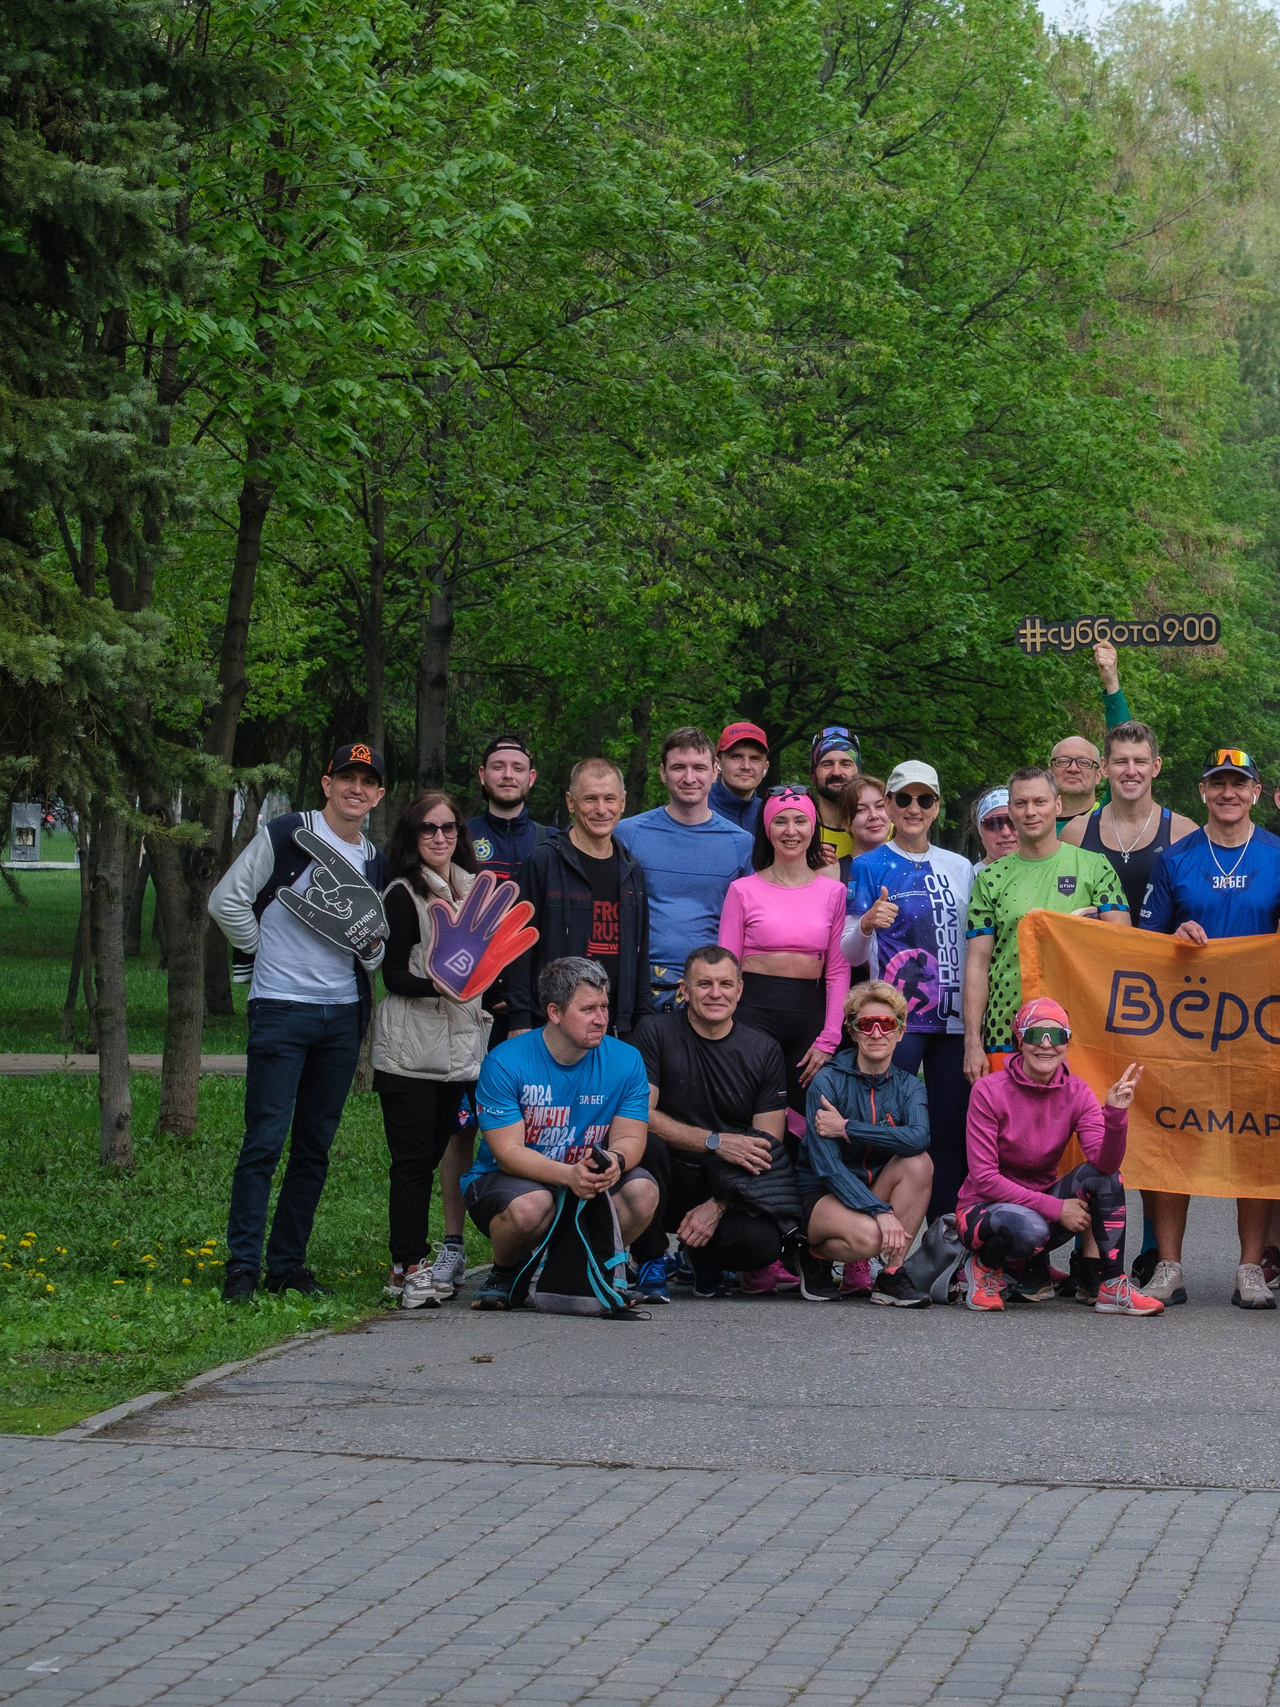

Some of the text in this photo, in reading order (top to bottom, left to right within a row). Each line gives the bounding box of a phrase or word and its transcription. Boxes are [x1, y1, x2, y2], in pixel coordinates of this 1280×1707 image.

[344, 908, 377, 938] NOTHING
[350, 926, 371, 945] ELSE
[520, 1084, 553, 1106] 2024
